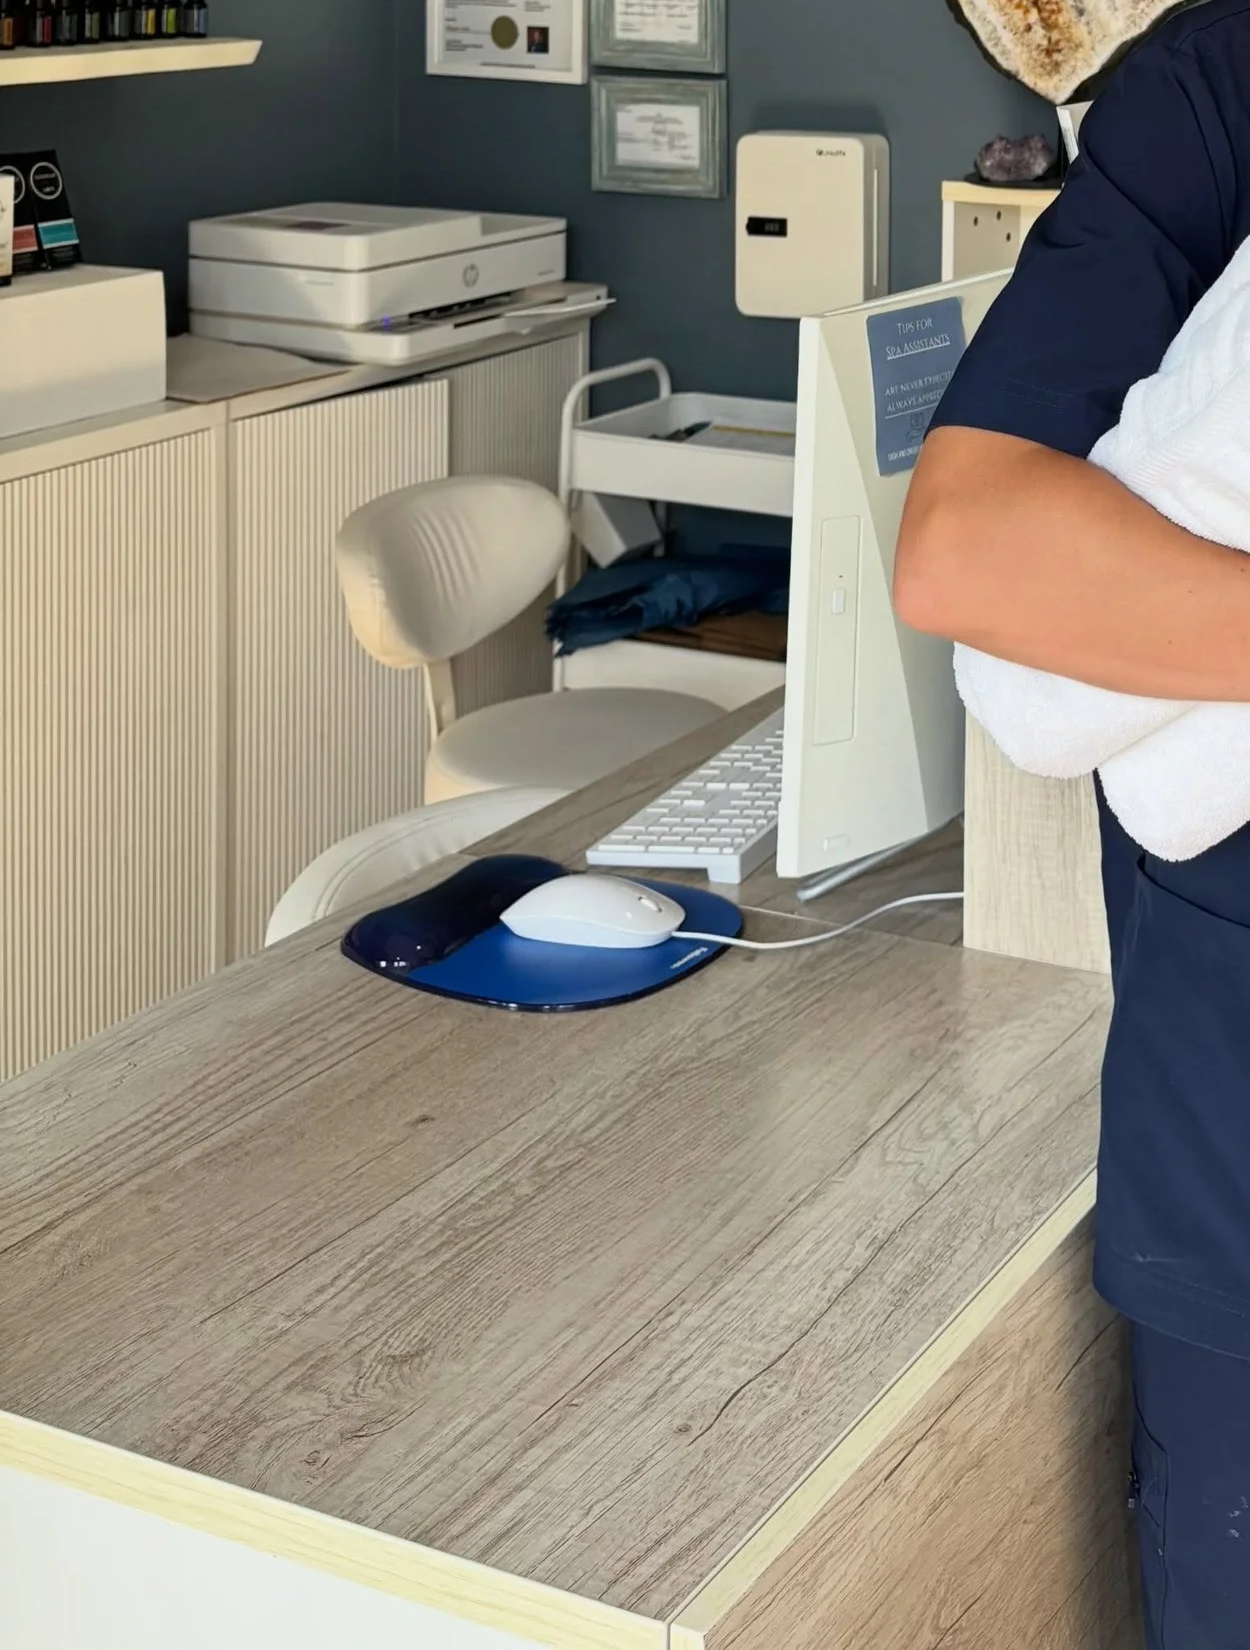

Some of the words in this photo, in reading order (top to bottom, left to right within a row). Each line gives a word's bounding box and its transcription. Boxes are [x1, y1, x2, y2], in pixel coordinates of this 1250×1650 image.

[896, 322, 915, 336] TIPS
[916, 317, 933, 331] FOR
[885, 344, 902, 358] SPA
[903, 333, 951, 353] ASSISTANTS
[887, 397, 916, 413] ALWAYS
[918, 390, 944, 404] APPREC
